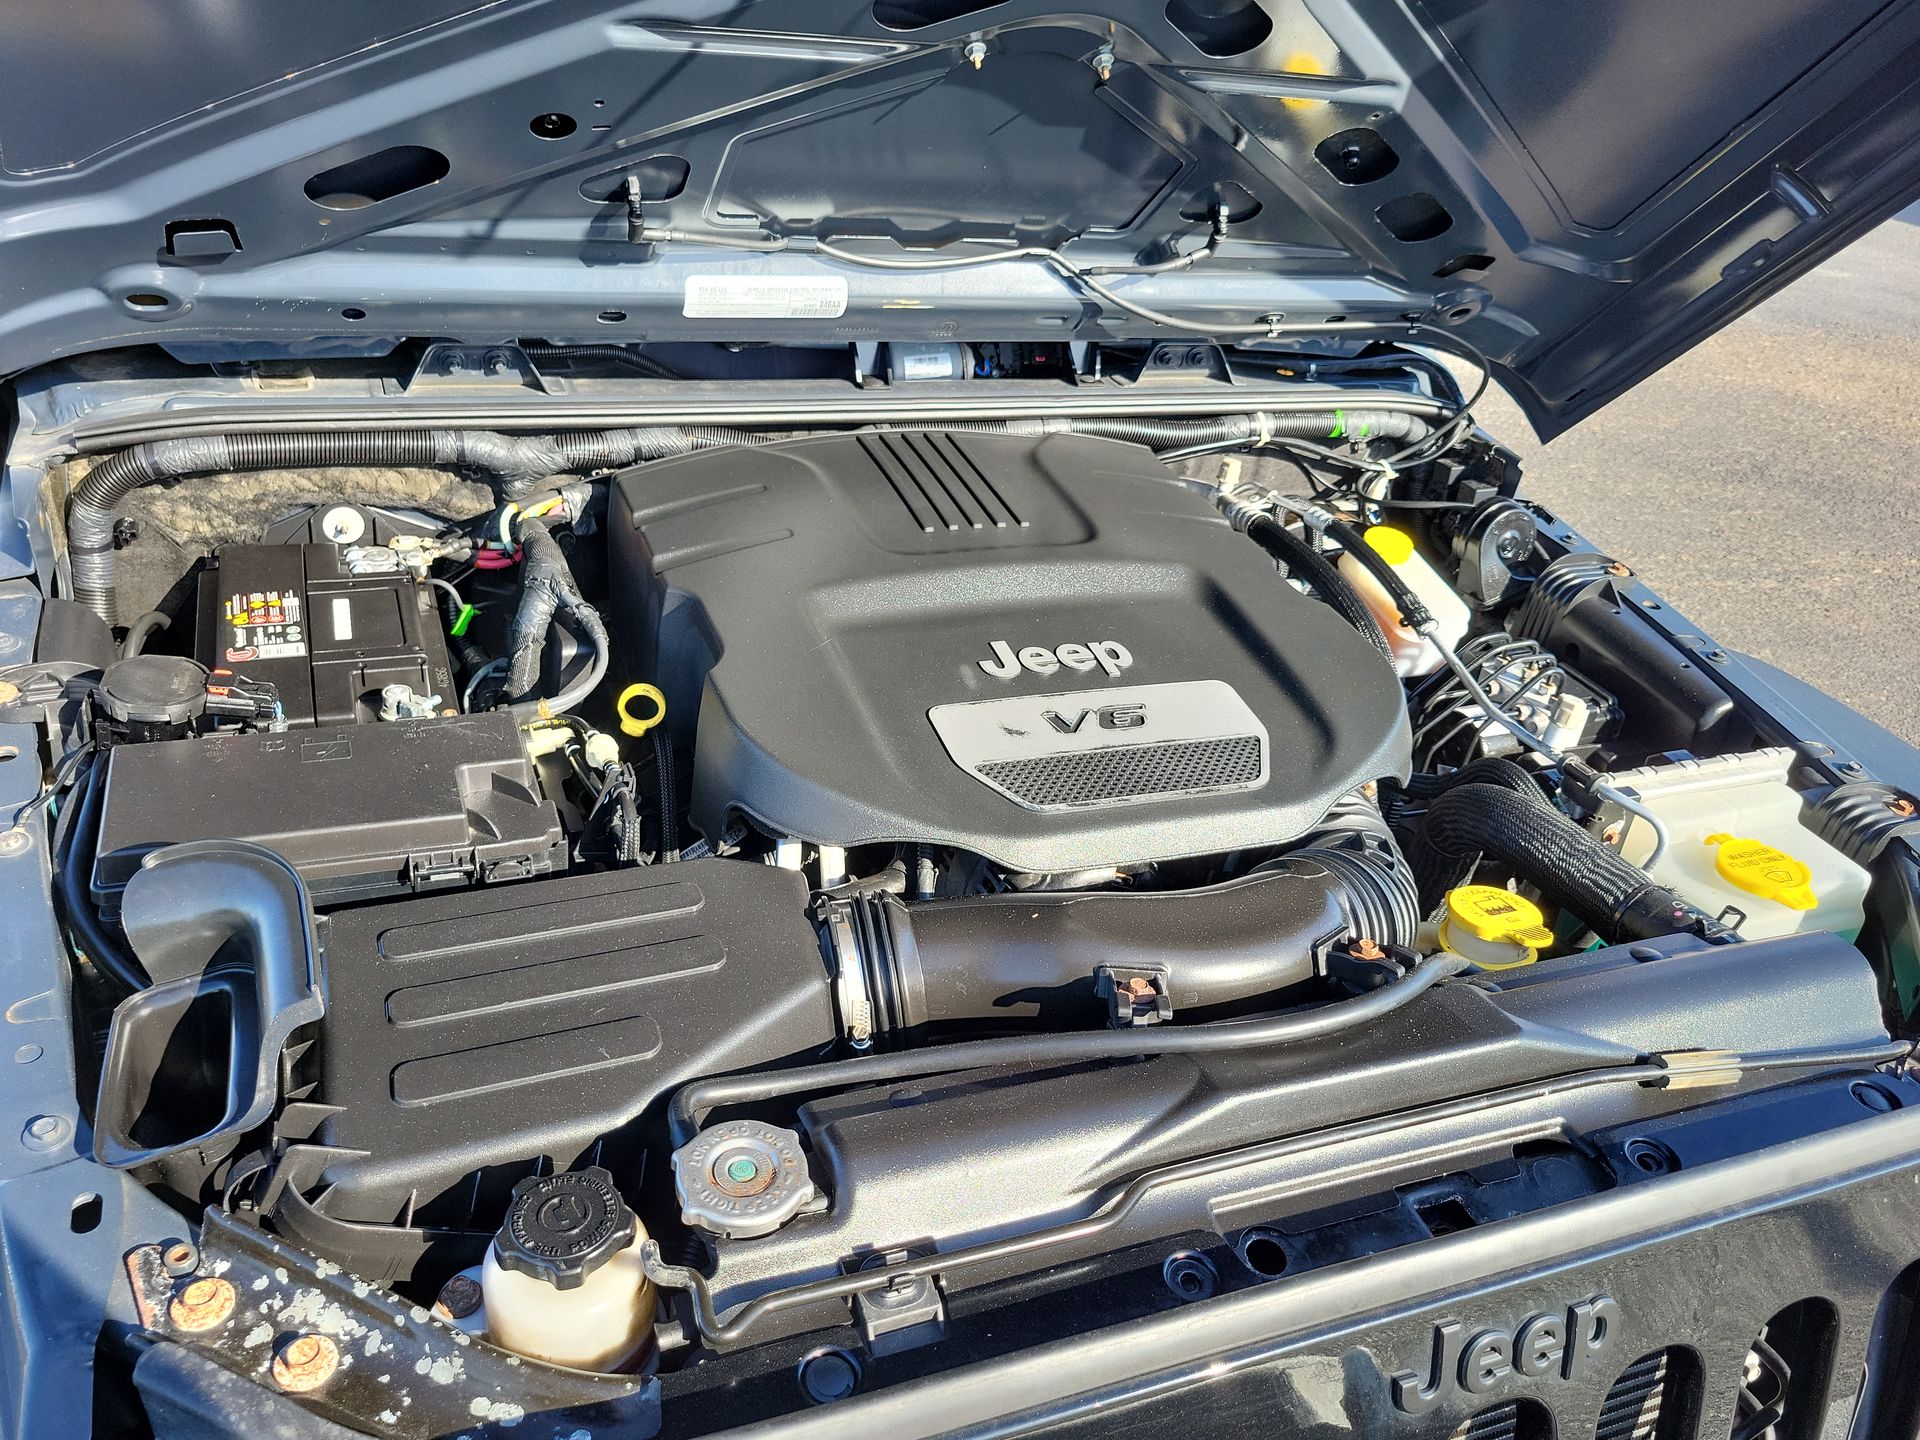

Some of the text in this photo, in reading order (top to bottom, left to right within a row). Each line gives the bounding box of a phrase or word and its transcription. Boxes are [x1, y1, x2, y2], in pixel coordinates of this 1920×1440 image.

[977, 639, 1134, 679] Jeep
[1040, 702, 1148, 735] V6
[1728, 847, 1773, 860] WASHER
[1728, 859, 1761, 869] FLUID
[1760, 853, 1786, 864] ONLY
[1391, 1294, 1618, 1414] Jeep
